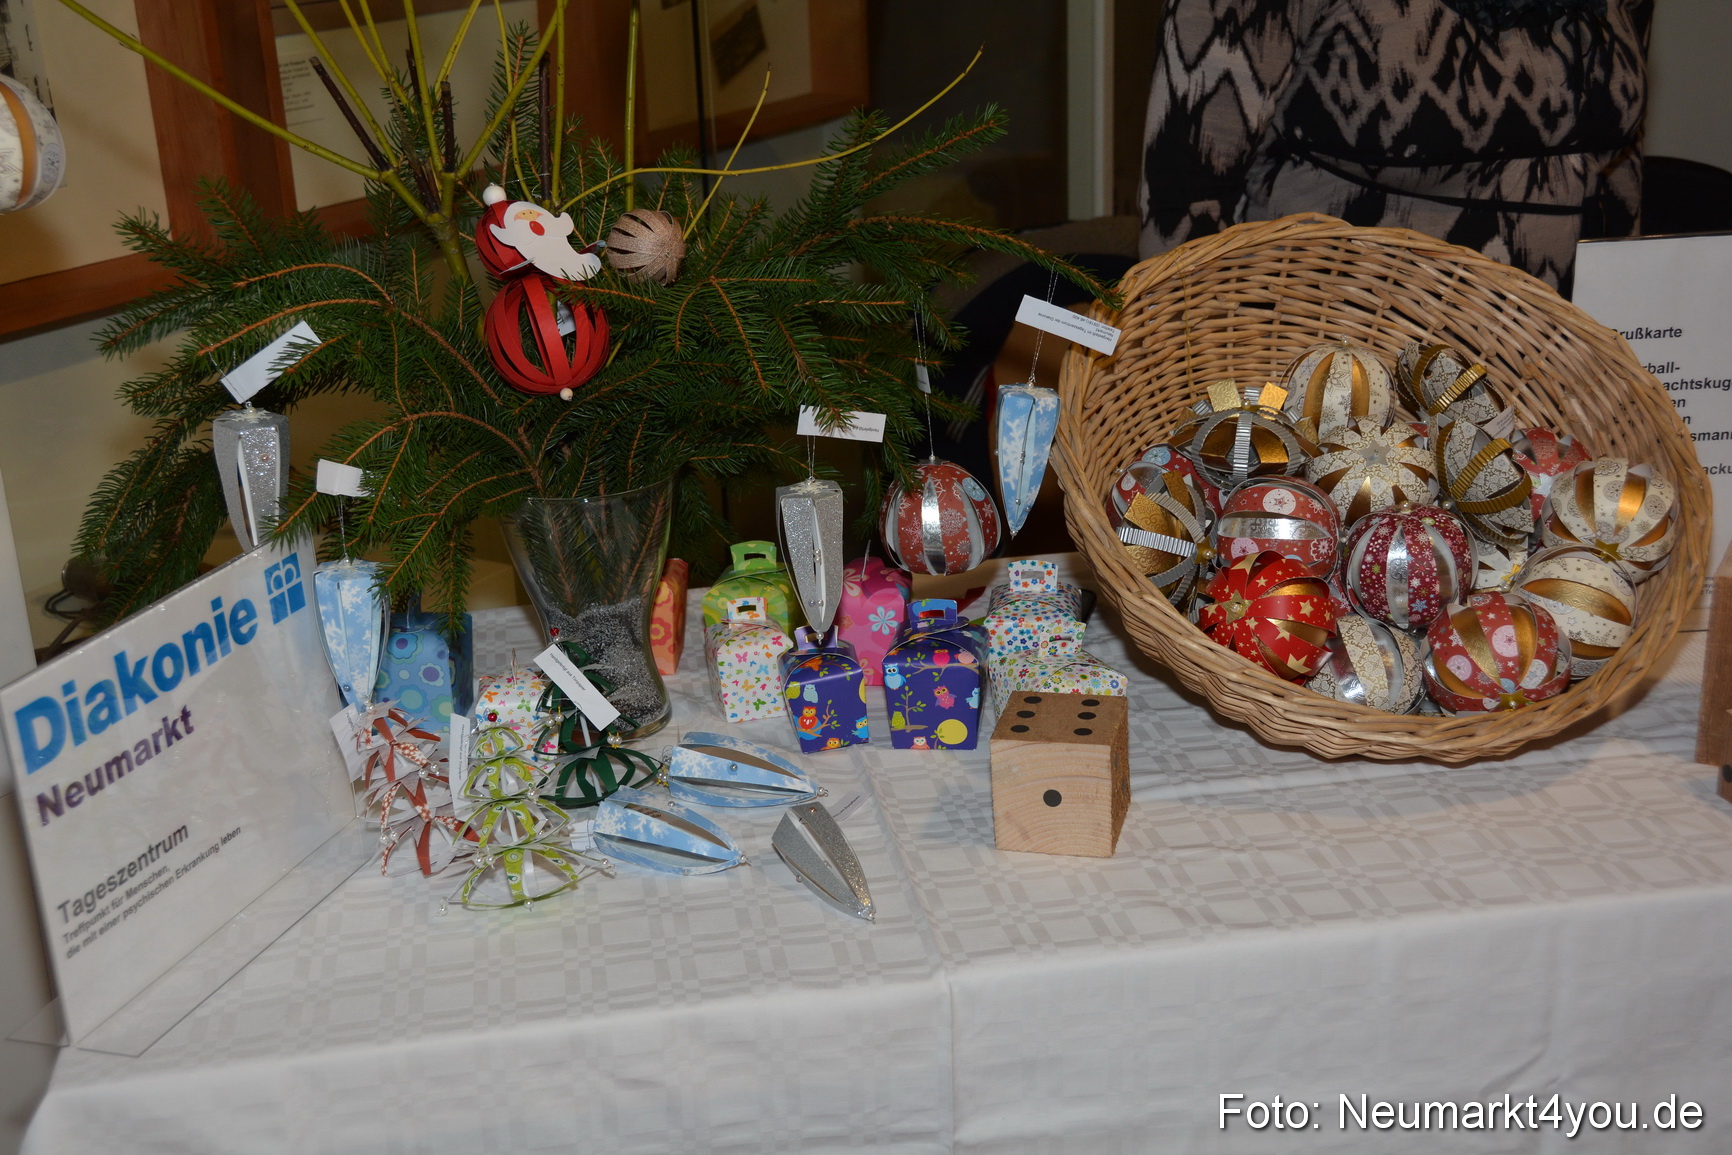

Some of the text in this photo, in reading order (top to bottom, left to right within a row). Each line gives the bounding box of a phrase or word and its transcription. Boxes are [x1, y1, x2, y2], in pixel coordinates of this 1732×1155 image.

[1612, 327, 1683, 340] rußkarte
[1663, 378, 1732, 391] achtskug
[14, 596, 259, 776] Diakonie
[36, 705, 195, 826] Neumarkt
[57, 824, 189, 924] Tageszentrum
[62, 864, 171, 944] Treffpunkt für Menschen,
[66, 826, 241, 959] die mit einer psychischen Erkrankung leben
